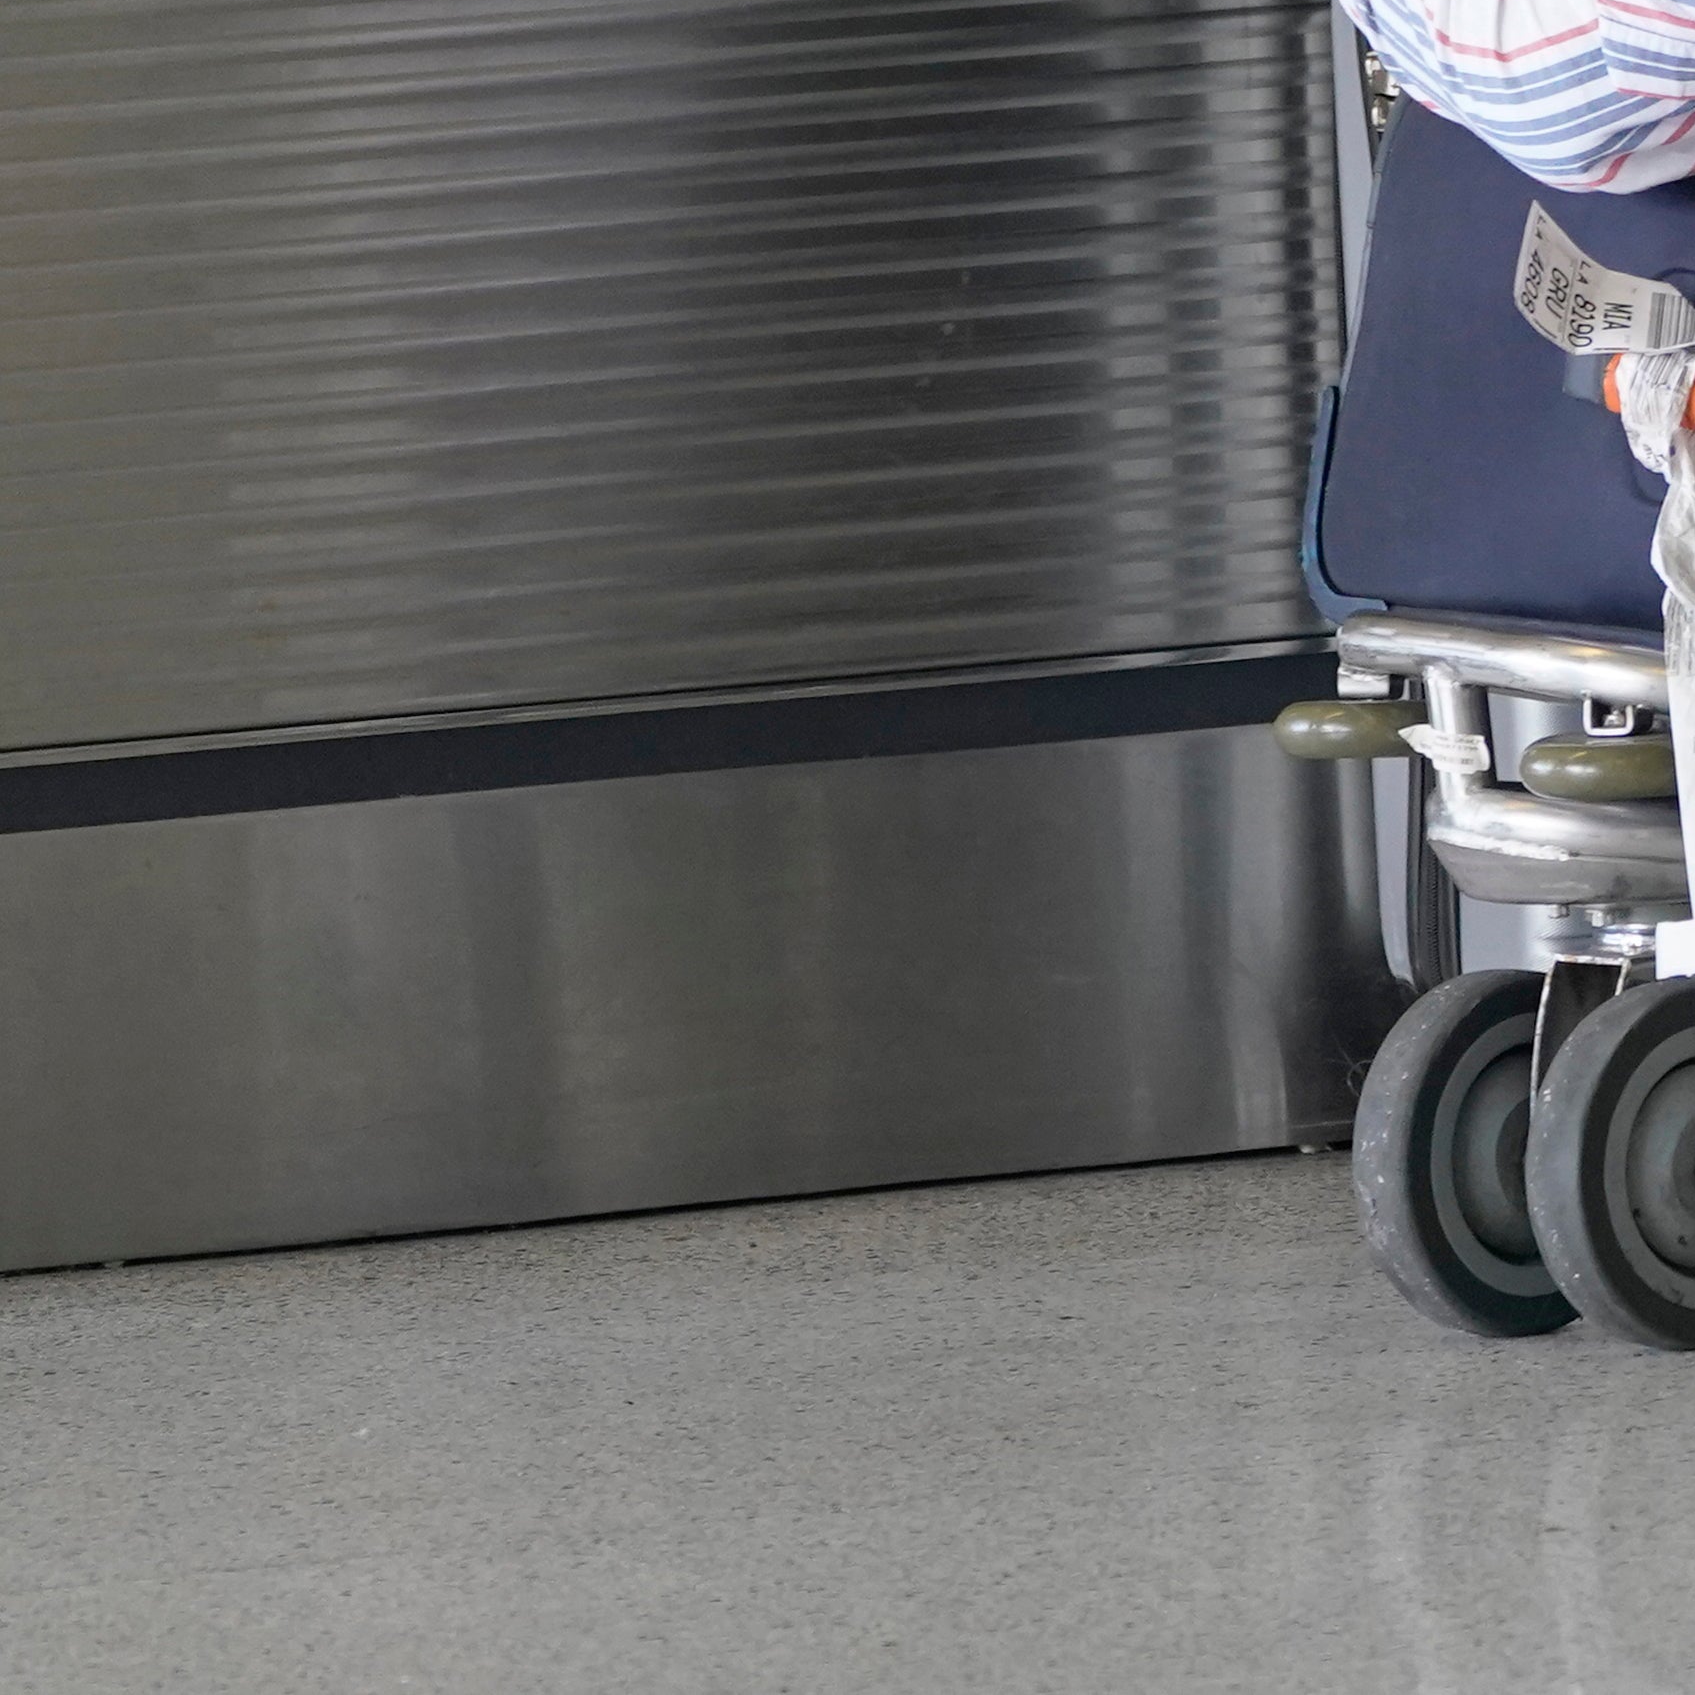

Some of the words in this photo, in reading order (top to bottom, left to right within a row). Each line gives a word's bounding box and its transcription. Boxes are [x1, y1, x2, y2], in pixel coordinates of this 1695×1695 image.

[1520, 249, 1545, 314] 4608
[1544, 267, 1570, 320] GRU
[1567, 294, 1597, 348] 8190
[1602, 302, 1634, 331] MIA
